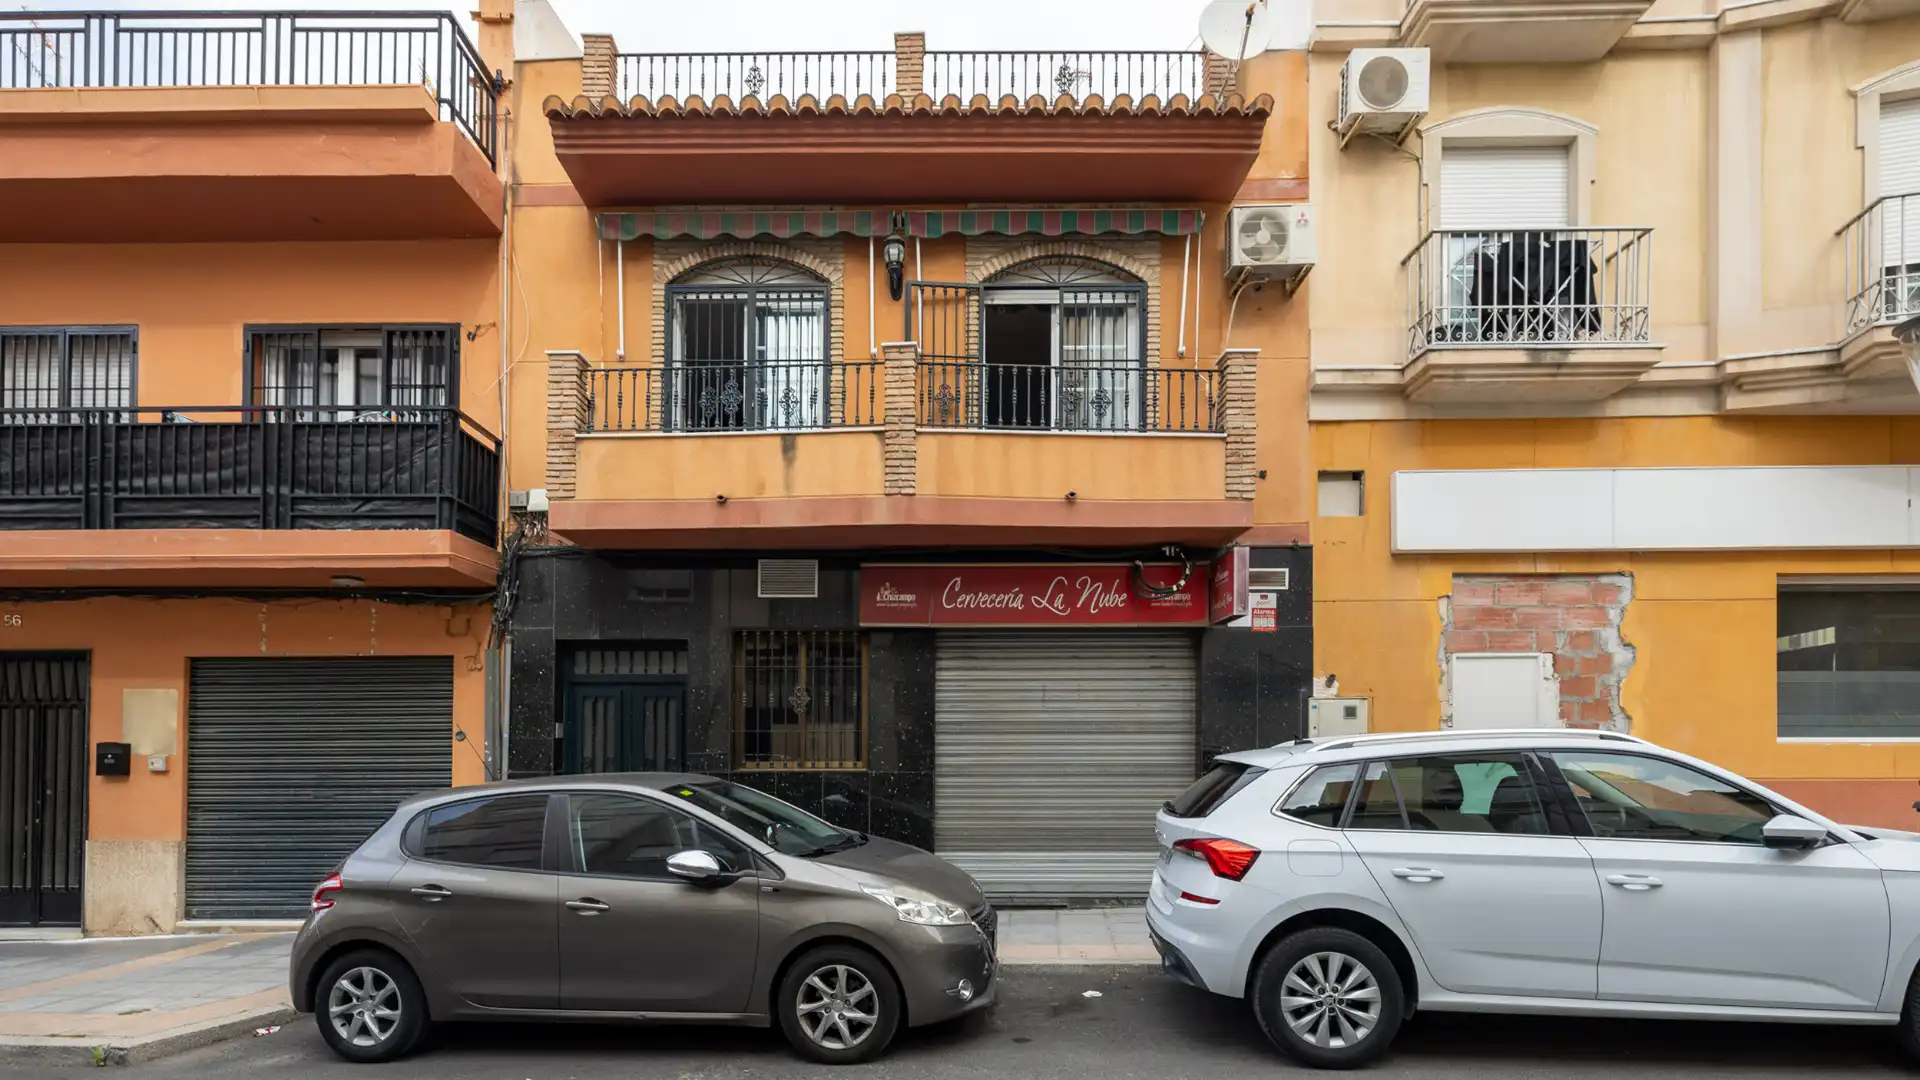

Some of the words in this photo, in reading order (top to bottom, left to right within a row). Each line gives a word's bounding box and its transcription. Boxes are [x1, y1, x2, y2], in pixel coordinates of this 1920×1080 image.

[942, 576, 1025, 609] Cervecería
[1031, 576, 1070, 615] La
[1076, 576, 1128, 613] Nube
[4, 614, 22, 626] 56
